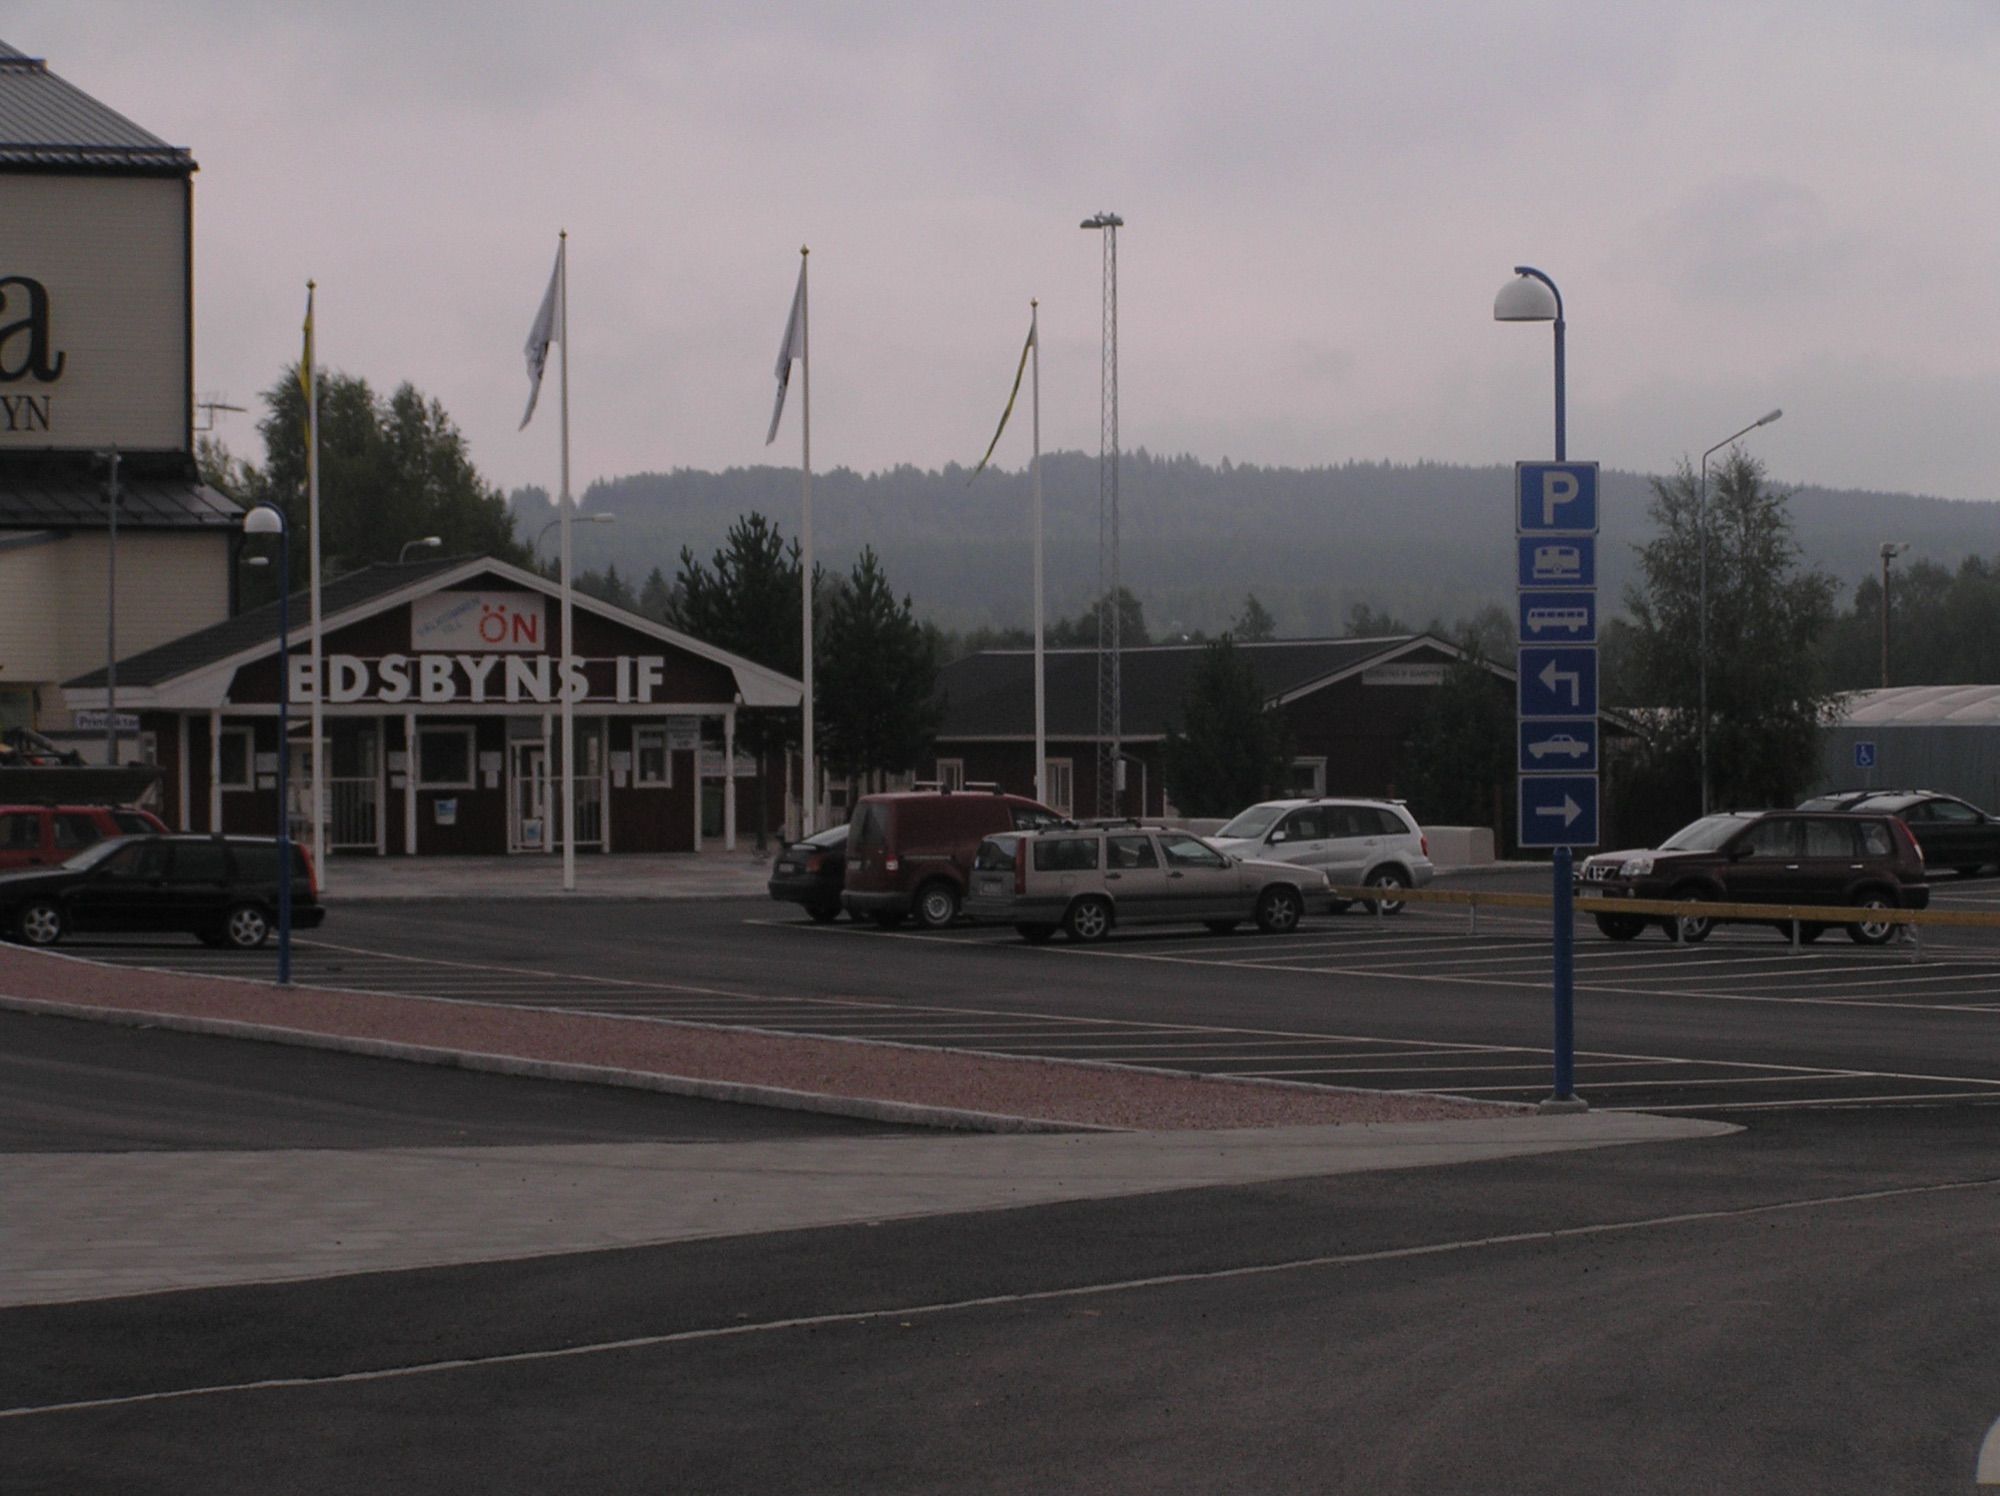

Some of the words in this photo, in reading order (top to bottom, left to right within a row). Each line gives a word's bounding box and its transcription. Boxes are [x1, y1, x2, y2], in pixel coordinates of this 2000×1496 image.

[1543, 470, 1580, 525] P
[479, 604, 537, 643] ÖN
[287, 654, 589, 703] EDSBYNS
[616, 655, 664, 704] IF
